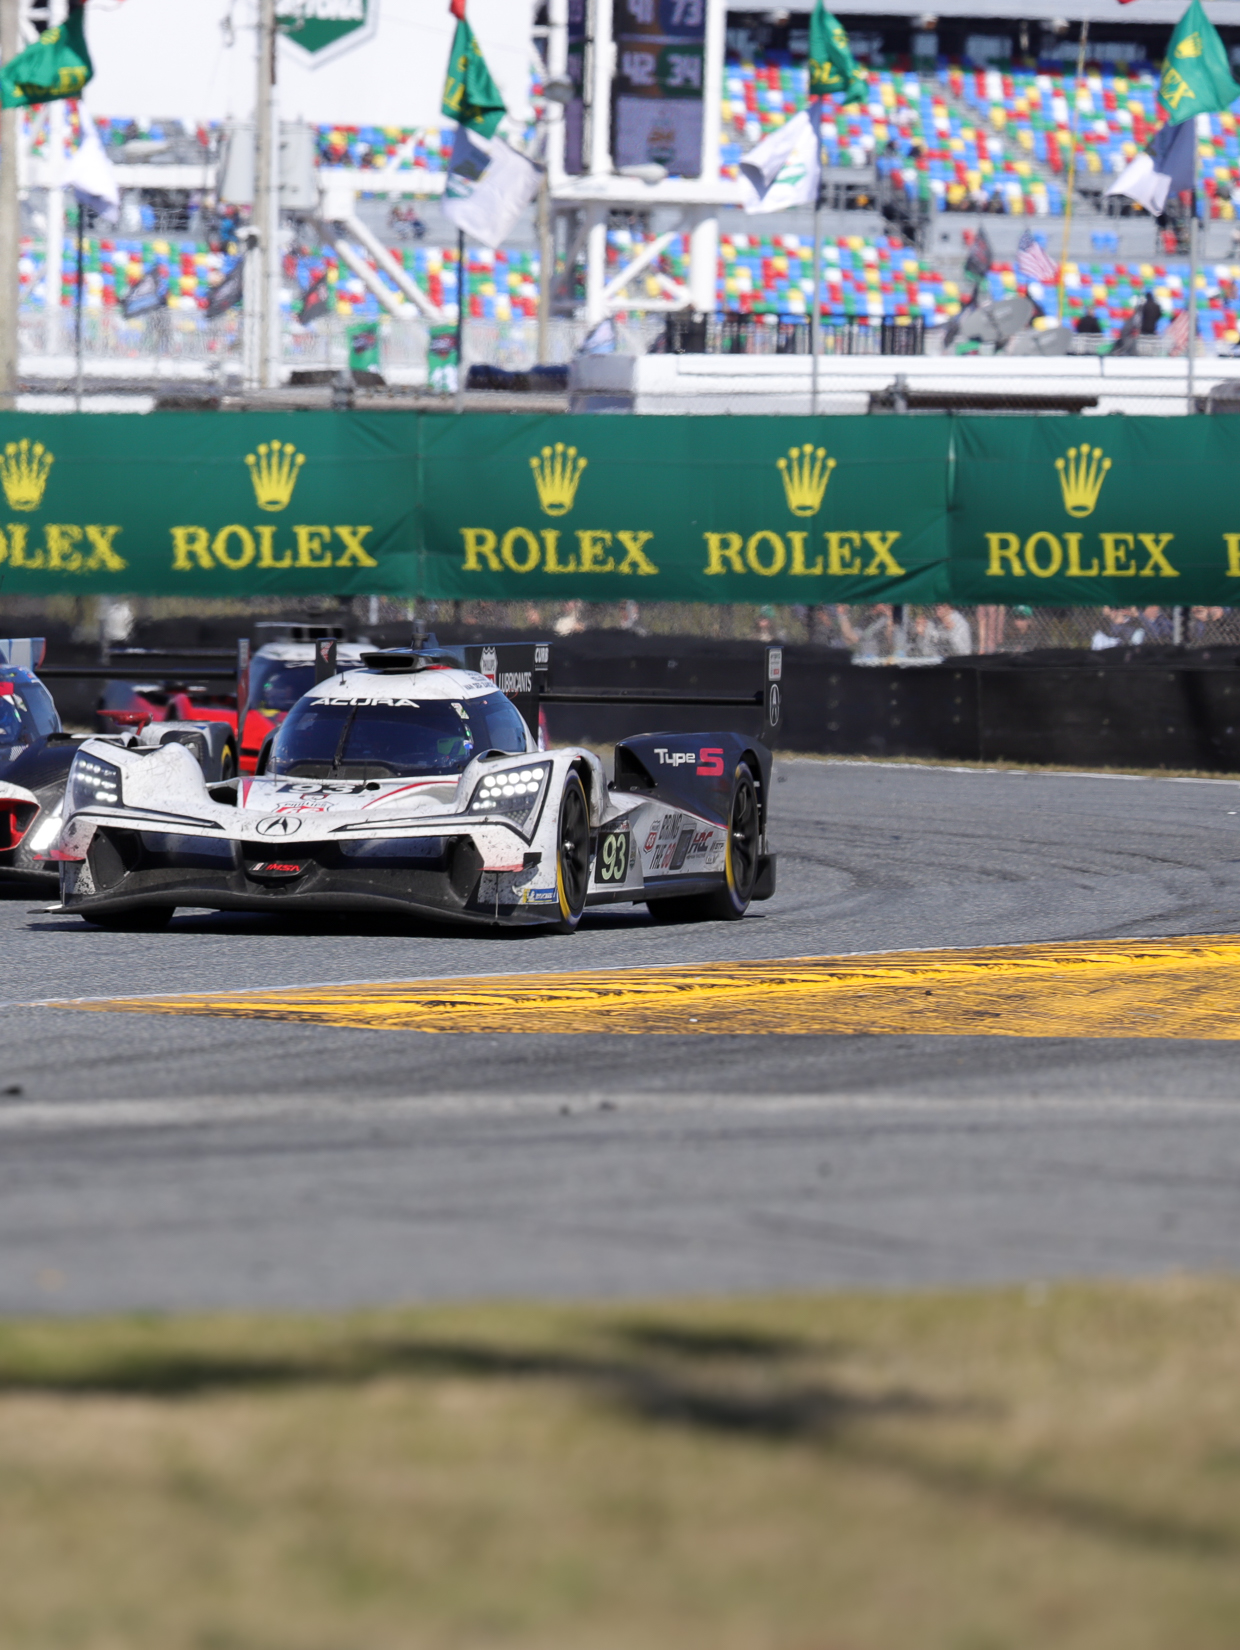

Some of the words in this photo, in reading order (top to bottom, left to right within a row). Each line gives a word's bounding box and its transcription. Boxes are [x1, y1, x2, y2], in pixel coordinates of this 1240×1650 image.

[621, 50, 656, 86] 42
[665, 53, 702, 88] 34
[170, 524, 378, 571] ROLEX
[460, 526, 659, 576] ROLEX
[703, 530, 906, 577] ROLEX
[984, 531, 1180, 578] ROLEX
[498, 671, 532, 693] LUBRICANTS
[309, 697, 421, 709] ACURA
[653, 748, 696, 767] Type
[696, 747, 725, 777] S
[288, 783, 356, 794] 93
[265, 863, 301, 872] IMSA
[601, 833, 626, 880] 93
